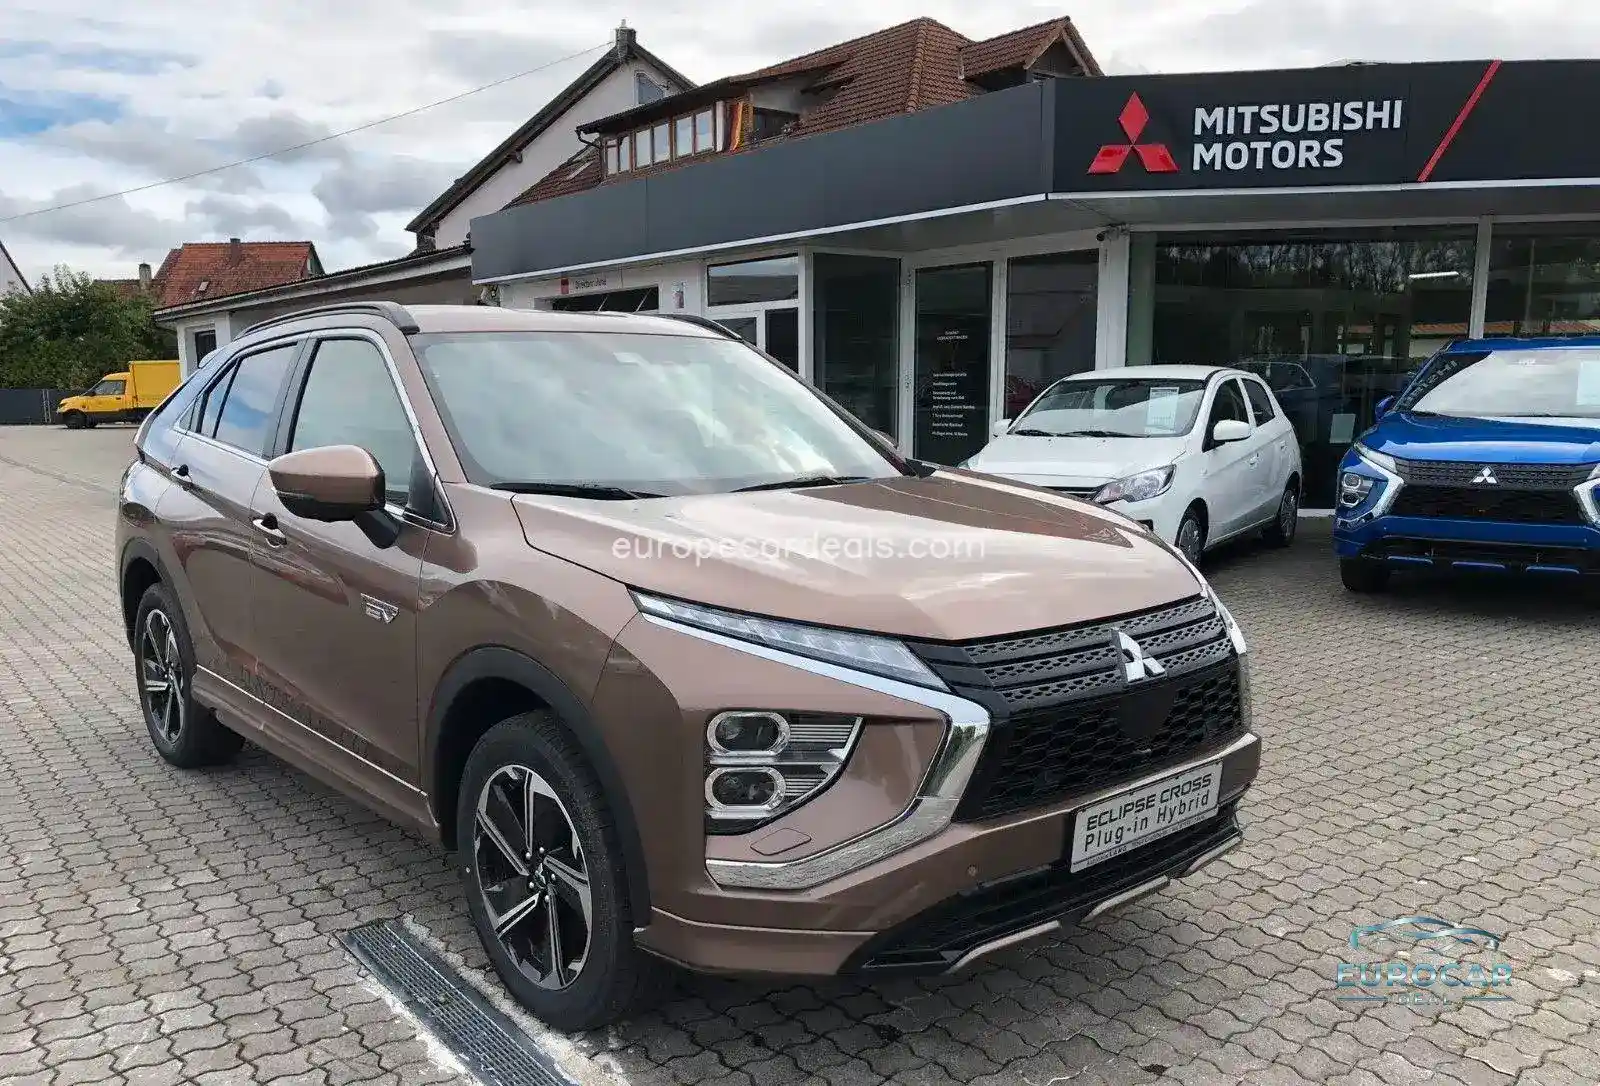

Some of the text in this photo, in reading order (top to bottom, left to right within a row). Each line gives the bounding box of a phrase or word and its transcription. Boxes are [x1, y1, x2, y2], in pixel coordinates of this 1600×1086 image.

[1194, 100, 1402, 135] MITSUBISHI
[1193, 138, 1343, 171] MOTORS
[1084, 815, 1148, 852] Plug-in
[1156, 789, 1210, 824] Hybrid
[1086, 793, 1156, 832] ECLIPSE
[1160, 773, 1212, 804] CROSS
